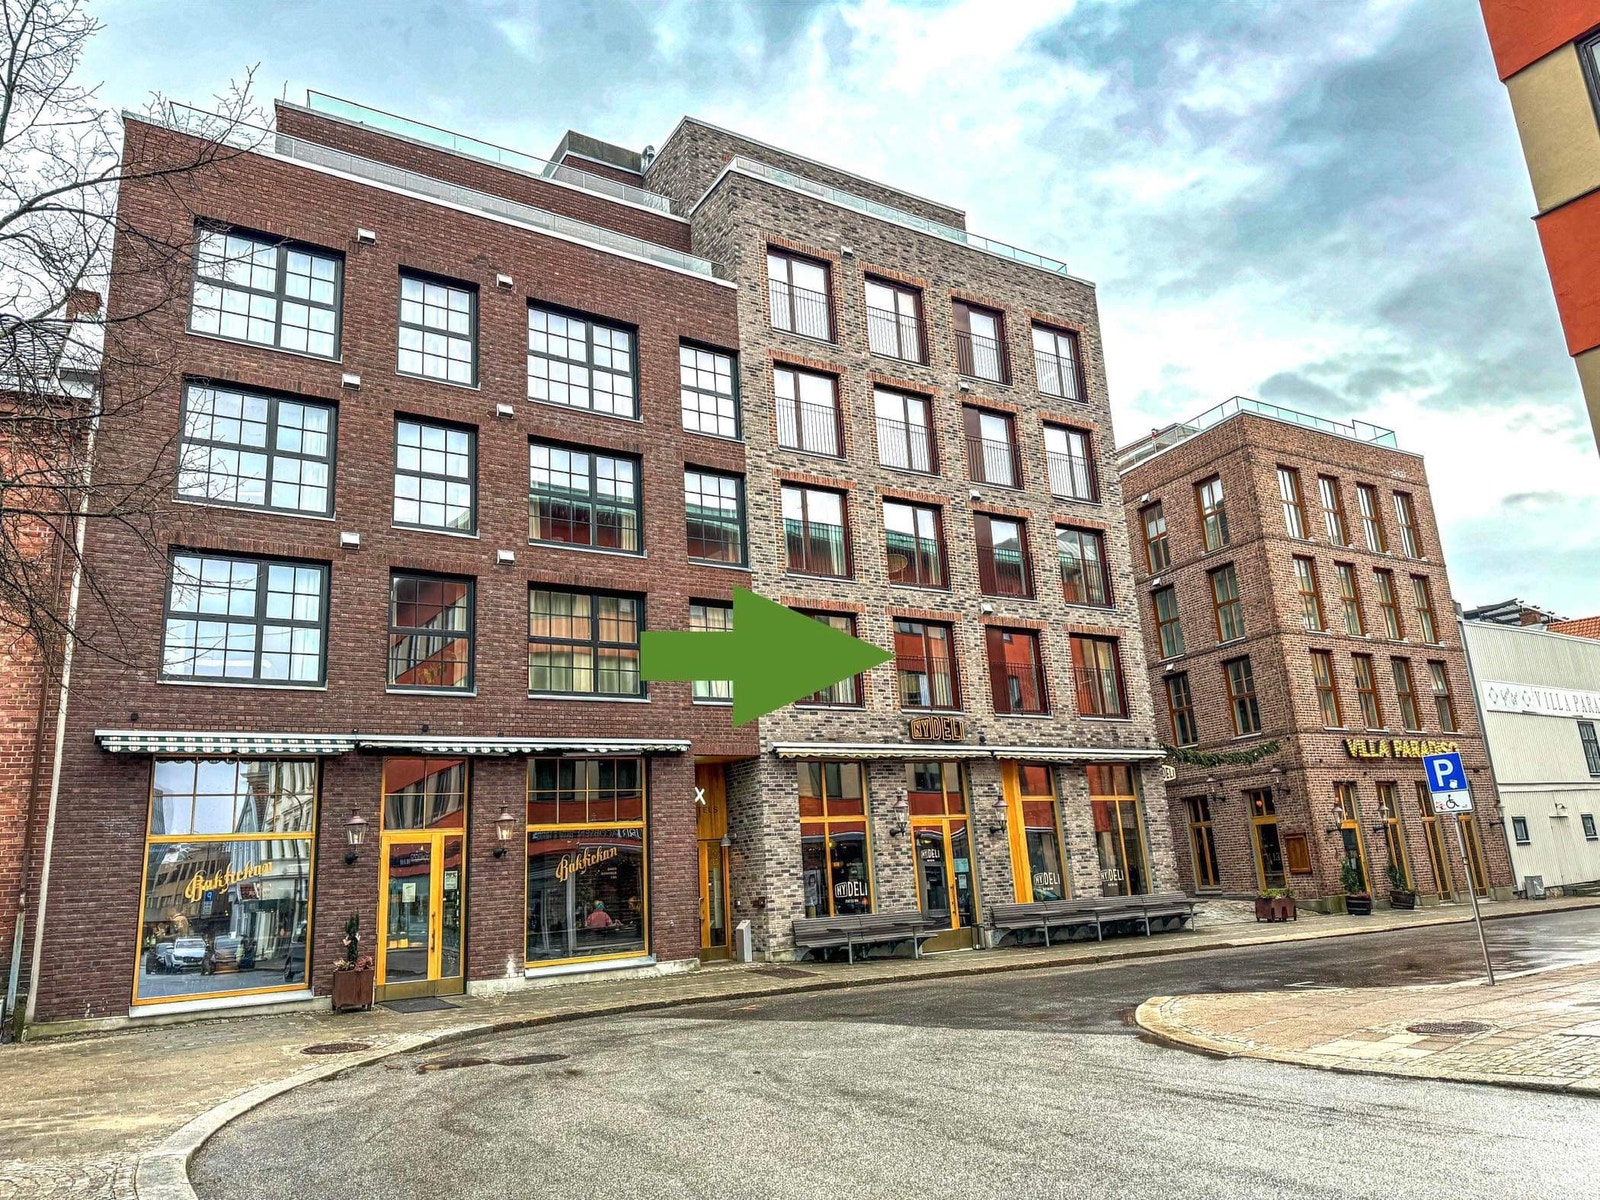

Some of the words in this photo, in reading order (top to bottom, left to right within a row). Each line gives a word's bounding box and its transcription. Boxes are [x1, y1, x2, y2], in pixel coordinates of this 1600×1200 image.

[1534, 690, 1571, 712] VILLA
[1572, 694, 1600, 714] PARA
[1346, 739, 1391, 757] VILLA
[1433, 759, 1454, 787] P
[555, 845, 618, 883] Bakfickan
[185, 860, 273, 903] Bakfickan
